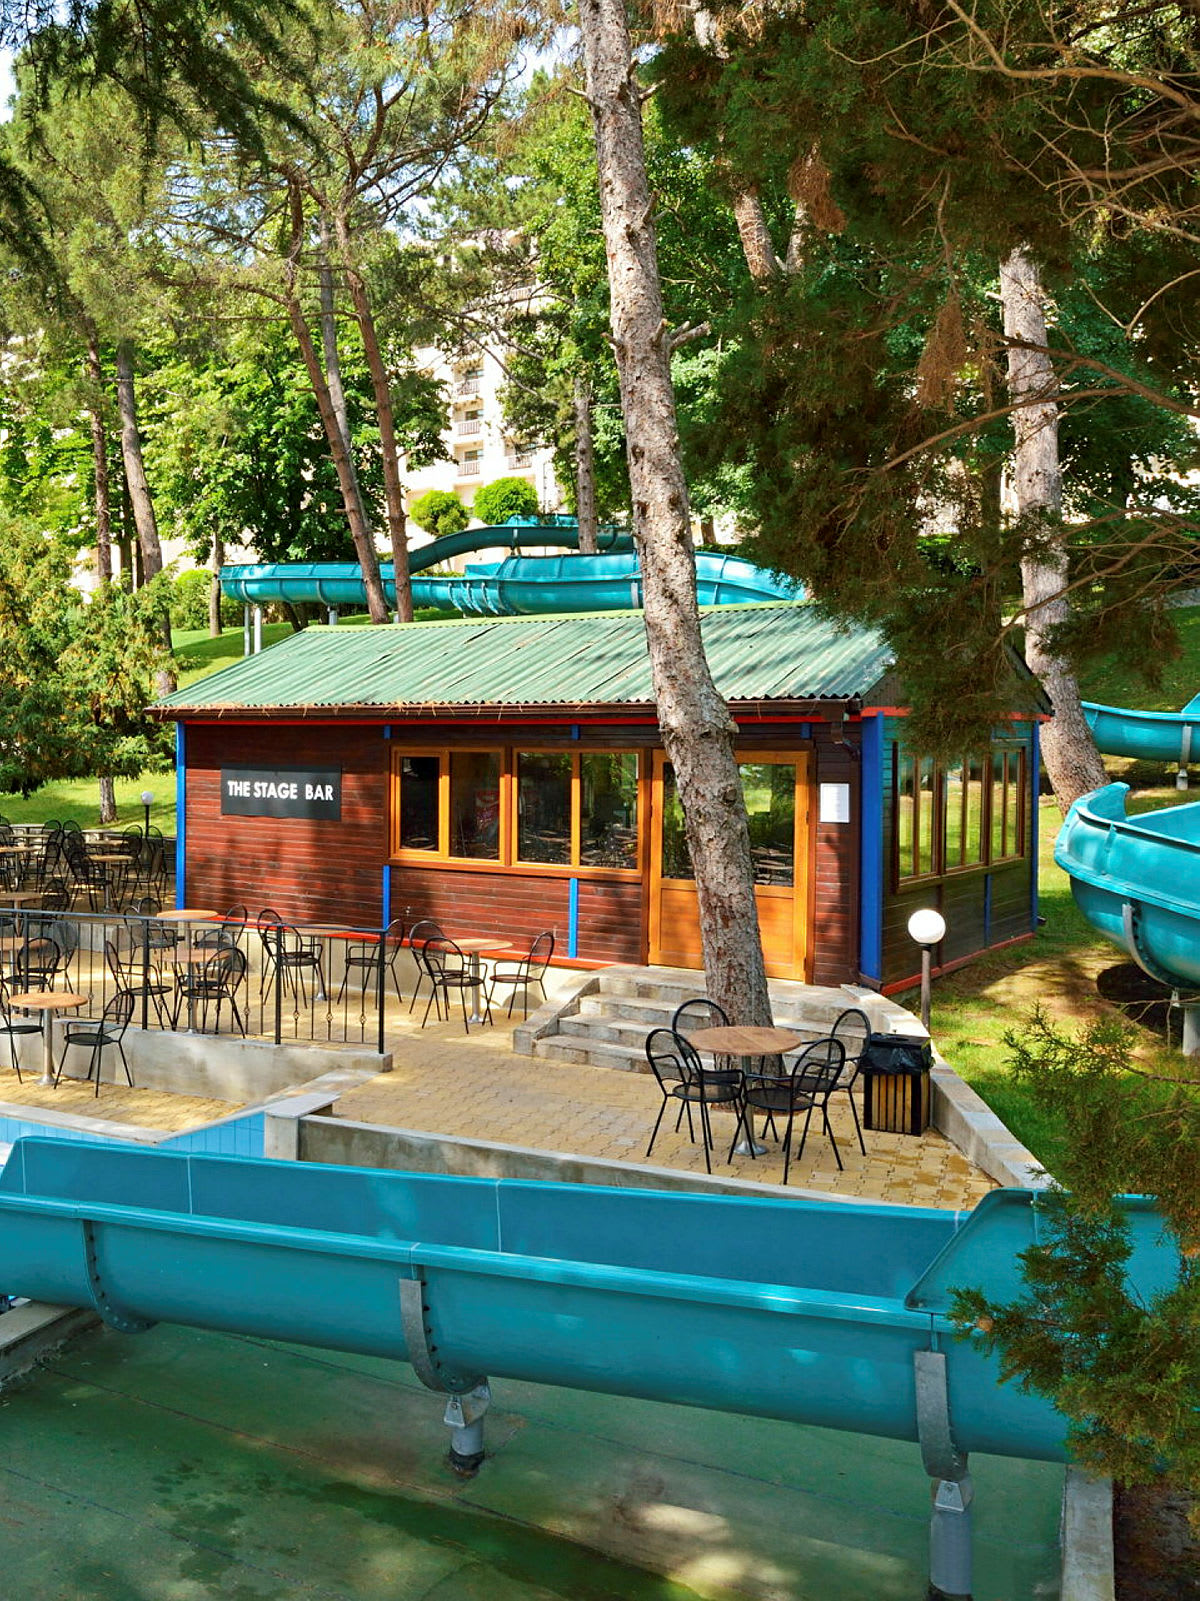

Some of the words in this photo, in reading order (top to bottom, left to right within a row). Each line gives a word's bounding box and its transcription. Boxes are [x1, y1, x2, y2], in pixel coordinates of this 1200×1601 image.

[227, 780, 251, 797] THE
[253, 782, 298, 799] STAGE
[305, 784, 334, 801] BAR
